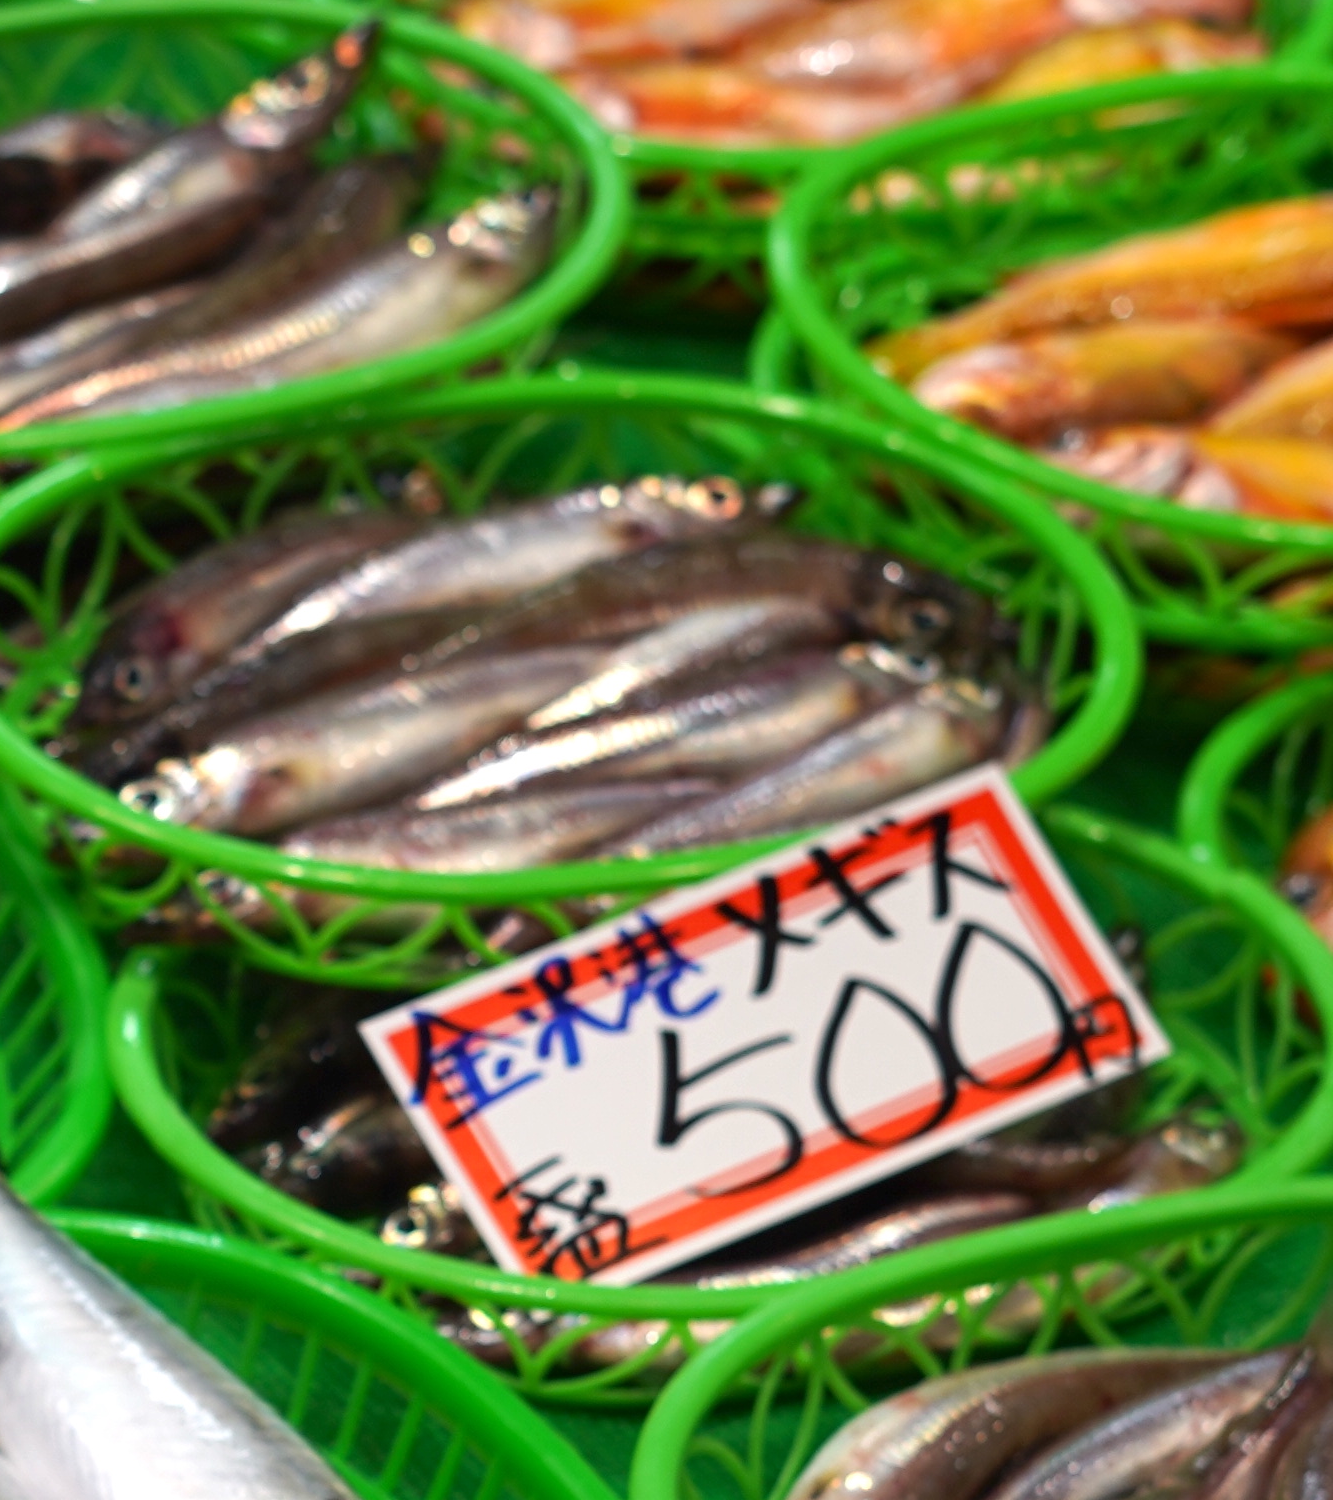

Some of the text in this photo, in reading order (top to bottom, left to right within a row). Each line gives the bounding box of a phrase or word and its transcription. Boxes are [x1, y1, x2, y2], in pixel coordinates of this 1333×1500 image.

[718, 810, 1013, 997] メギス
[656, 921, 1140, 1198] 500円
